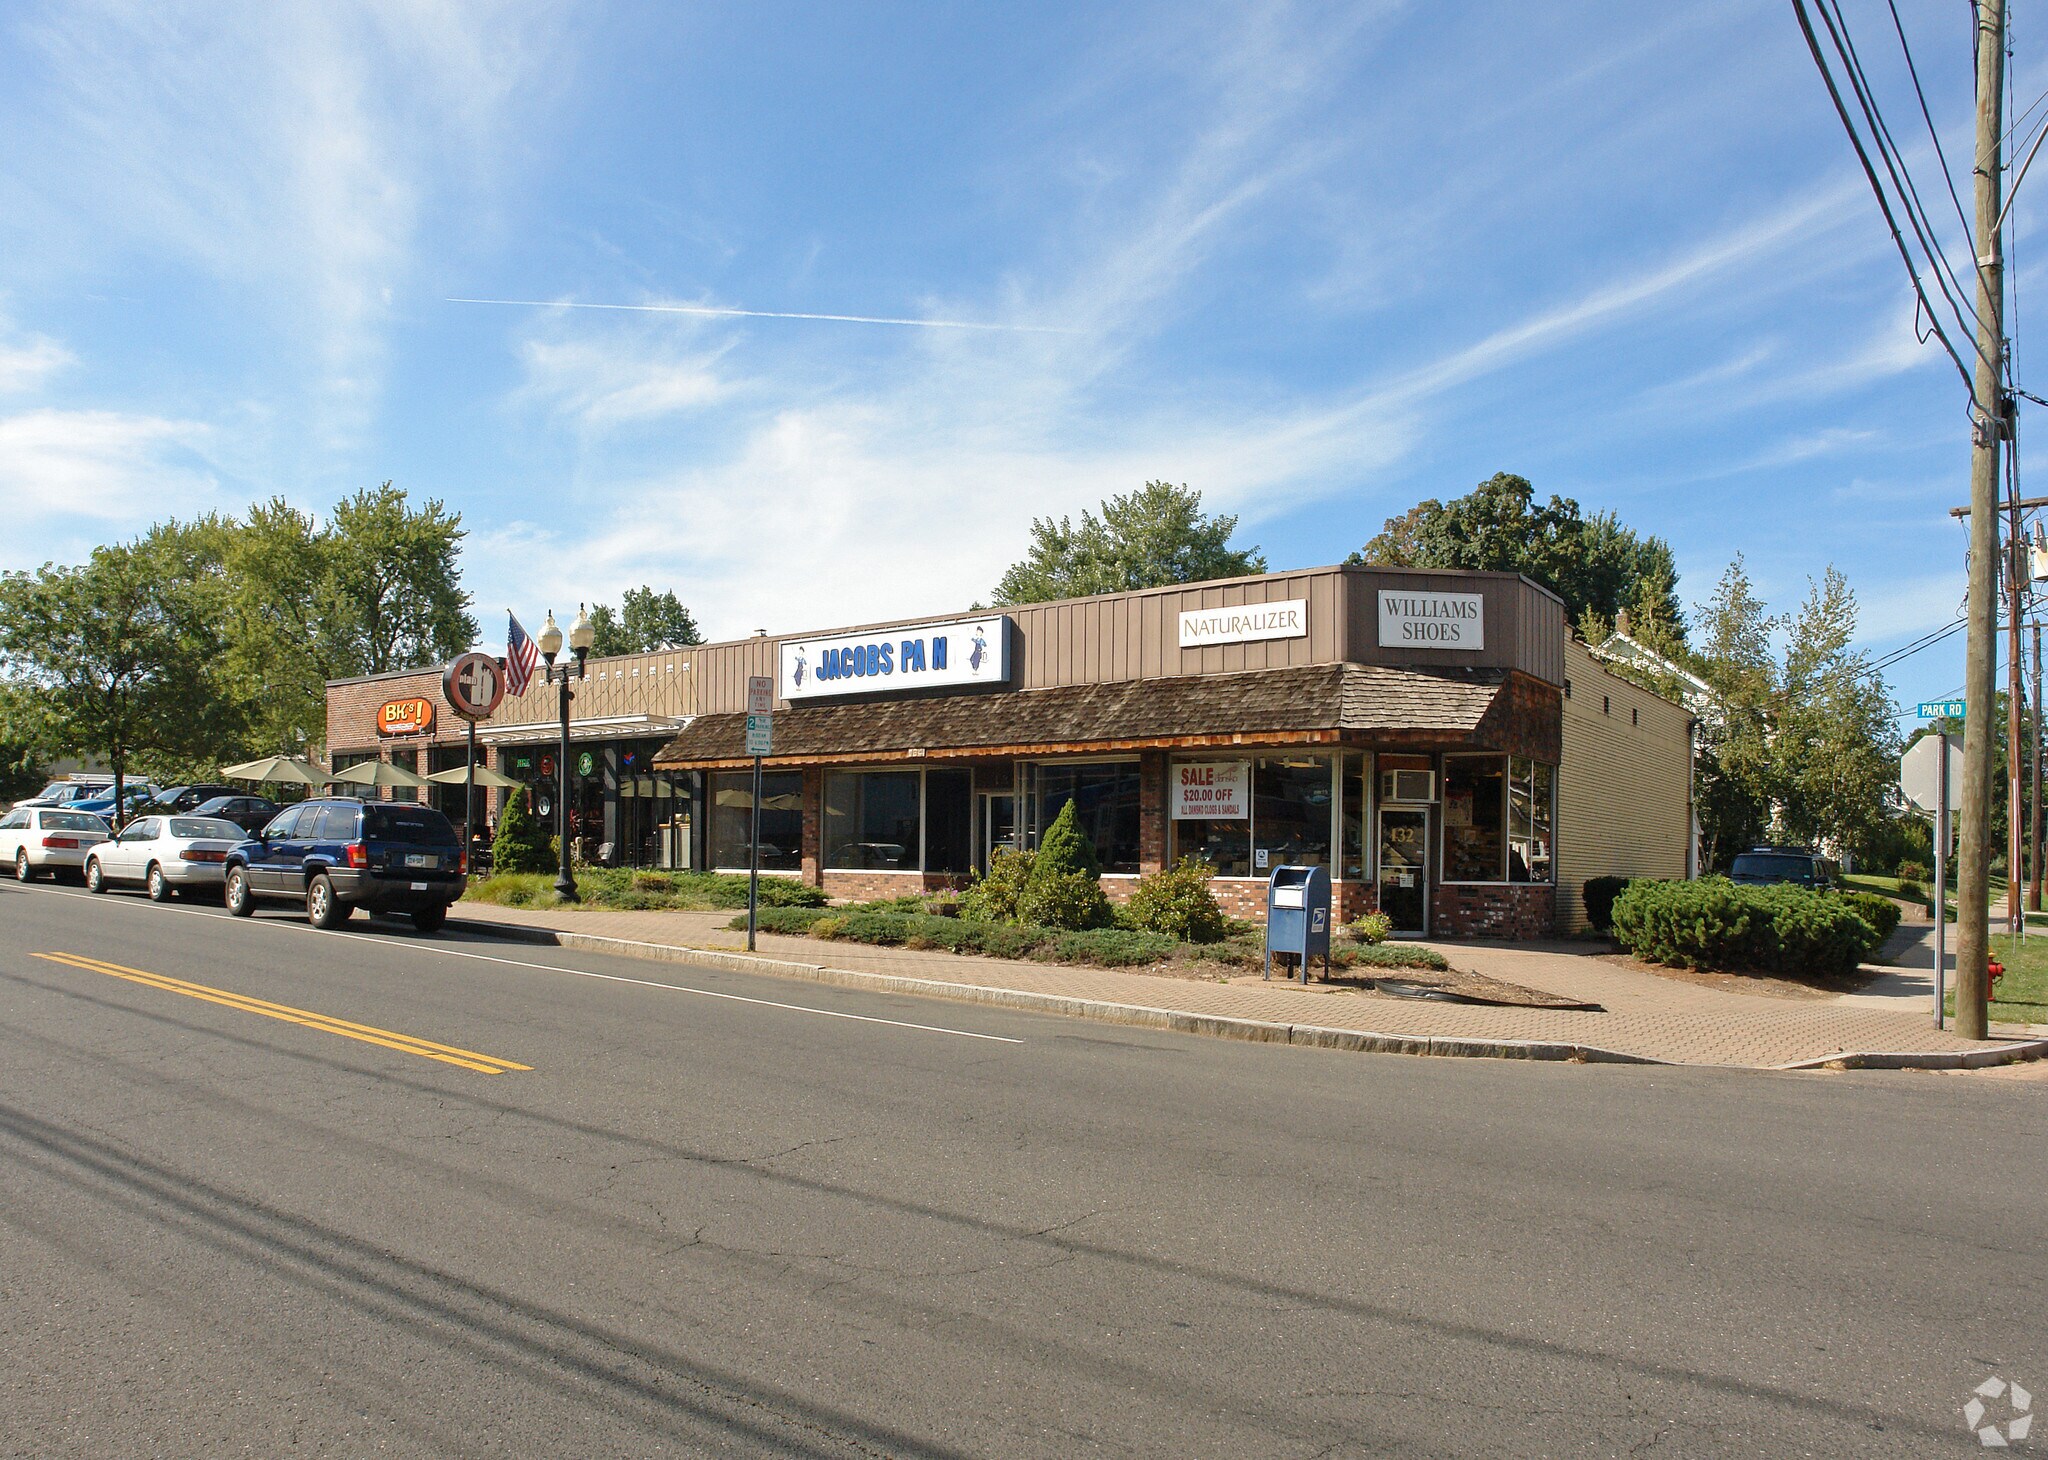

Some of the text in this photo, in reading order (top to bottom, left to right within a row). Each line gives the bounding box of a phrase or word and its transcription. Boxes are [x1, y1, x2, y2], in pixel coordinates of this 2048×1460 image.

[1385, 598, 1478, 619] WILLIAMS
[1184, 610, 1299, 638] NATURALIZER
[1402, 621, 1461, 641] SHOES
[816, 642, 894, 681] JACOBS
[756, 680, 767, 688] NO
[750, 688, 772, 696] PARKING
[1921, 703, 1962, 716] PARK RD
[749, 718, 755, 728] 2
[1181, 767, 1214, 786] SALE
[1183, 788, 1233, 803] $20.00 OFF
[1180, 805, 1188, 815] ALL
[1391, 827, 1415, 843] 132
